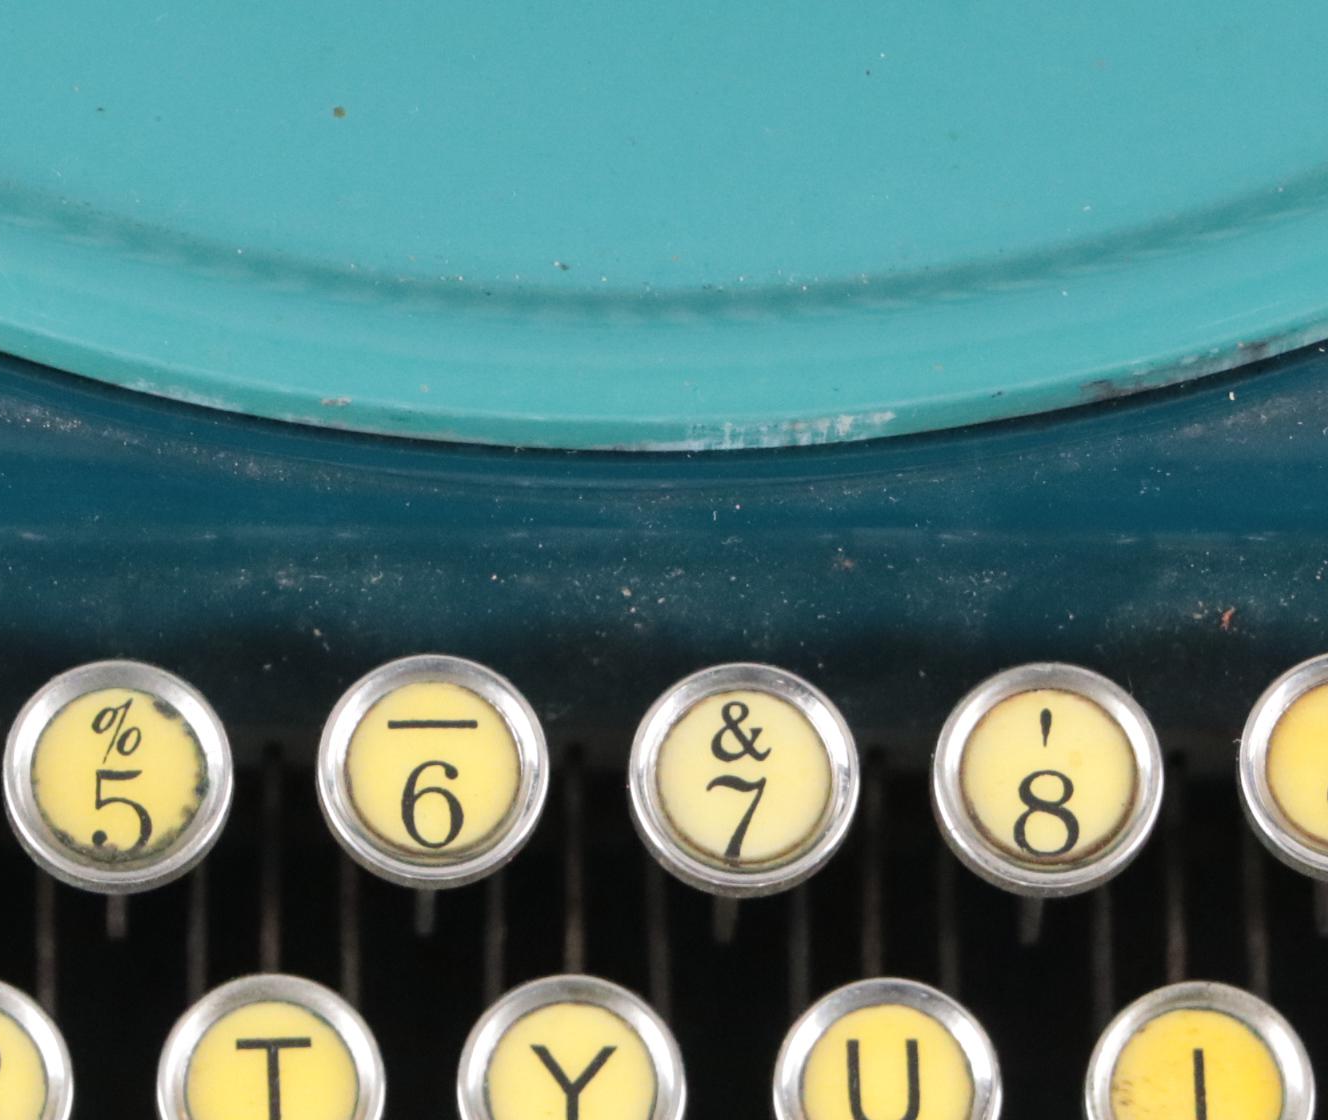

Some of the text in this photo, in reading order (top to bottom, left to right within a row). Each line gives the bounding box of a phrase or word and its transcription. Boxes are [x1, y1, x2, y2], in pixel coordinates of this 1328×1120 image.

[91, 698, 142, 764] %
[711, 701, 772, 763] &
[91, 768, 153, 852] 5
[401, 760, 464, 850] 6
[706, 775, 767, 861] 7
[1013, 769, 1080, 857] 8
